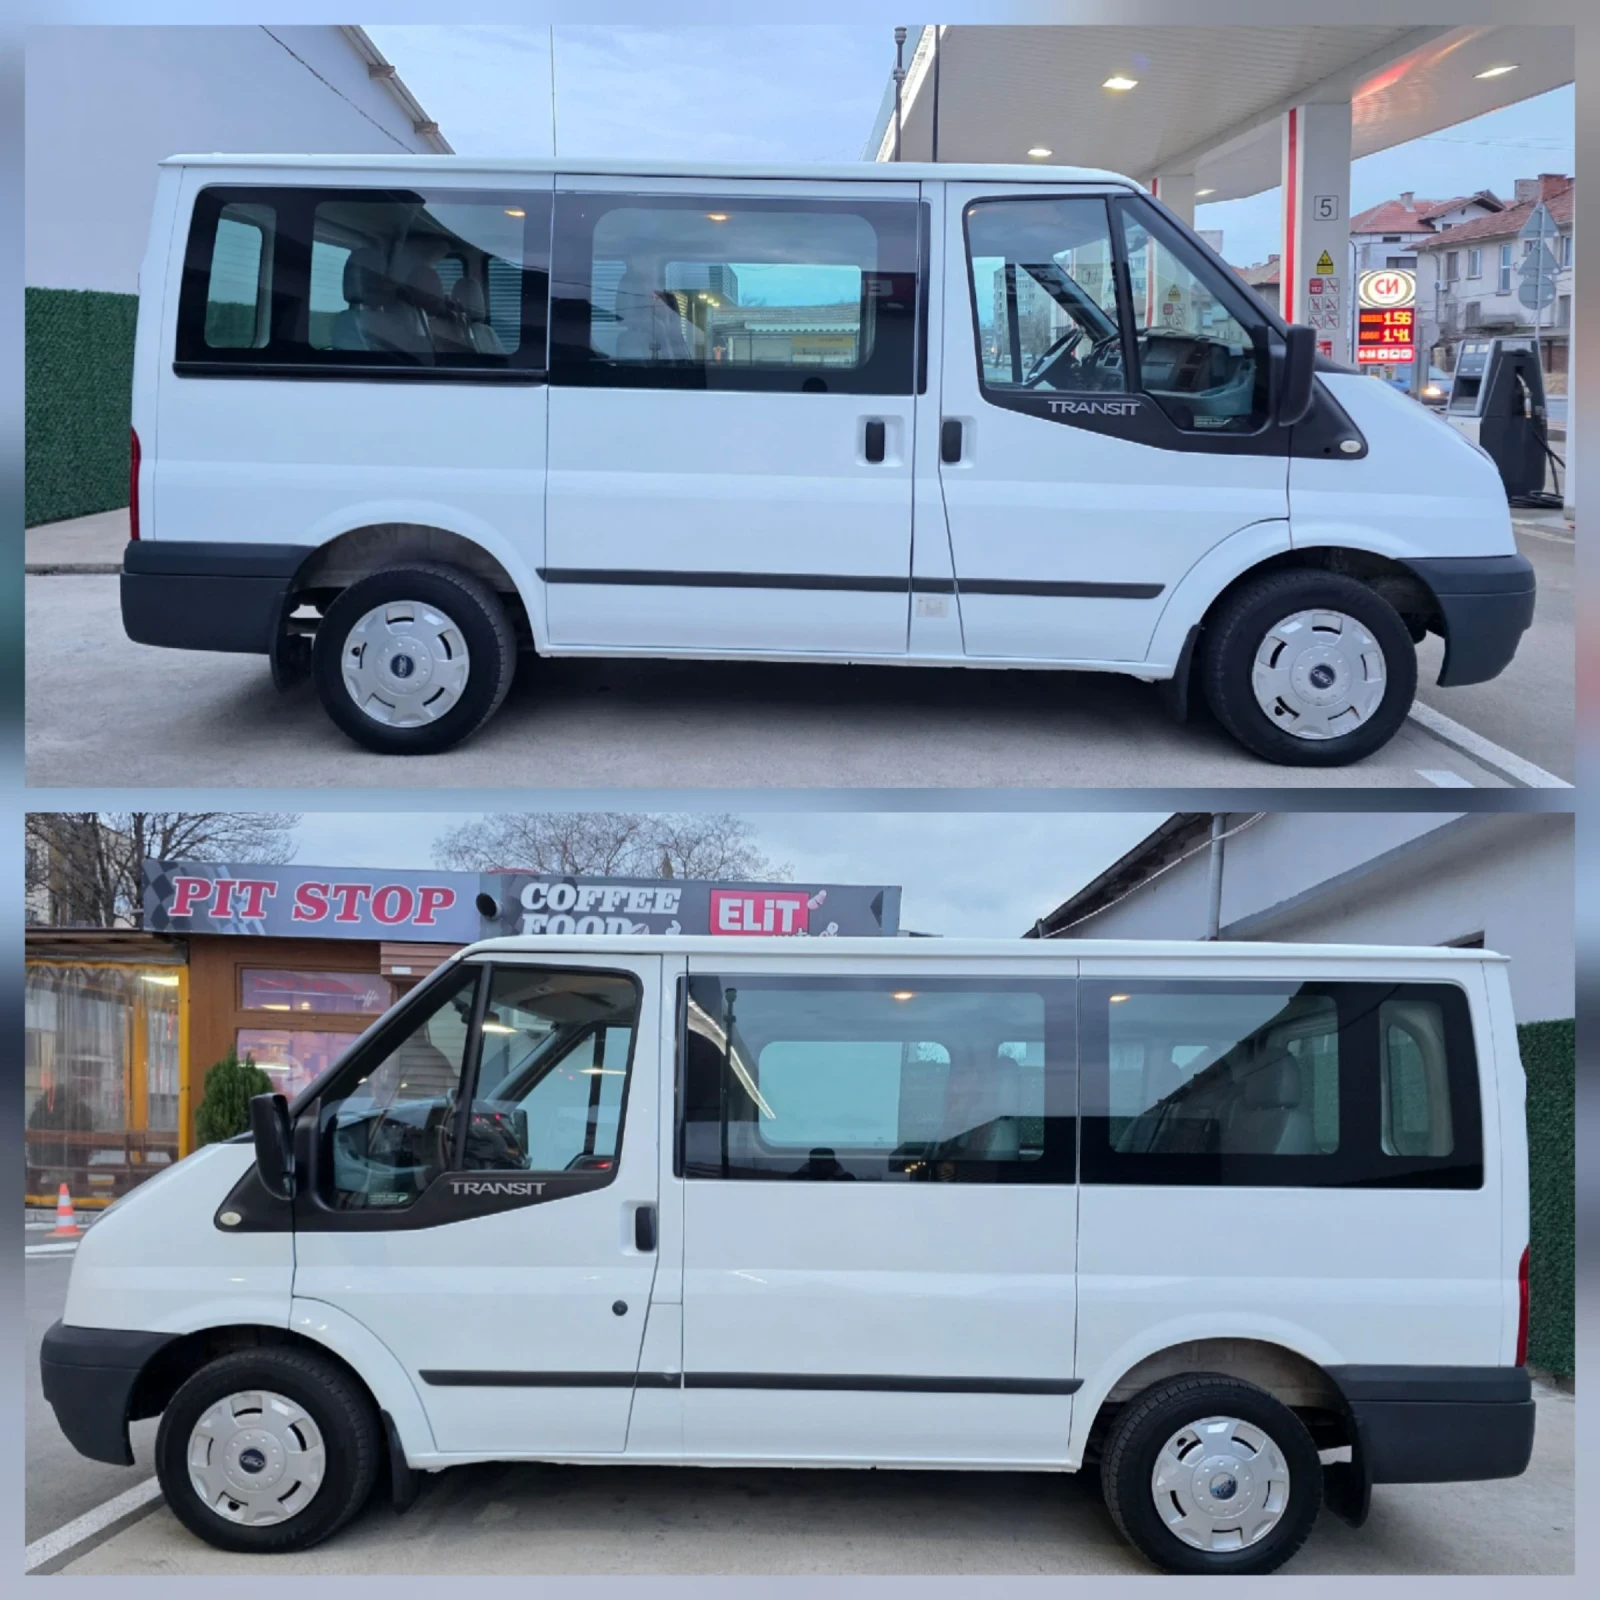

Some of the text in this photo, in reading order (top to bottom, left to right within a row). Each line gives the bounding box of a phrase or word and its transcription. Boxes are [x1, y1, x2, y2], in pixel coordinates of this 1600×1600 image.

[1320, 198, 1332, 218] 5
[1048, 400, 1141, 416] TRANSIT
[167, 876, 457, 926] PIT STOP
[520, 882, 682, 915] COFFEE
[521, 913, 634, 936] FOOD
[450, 1181, 546, 1196] TRANSIT
